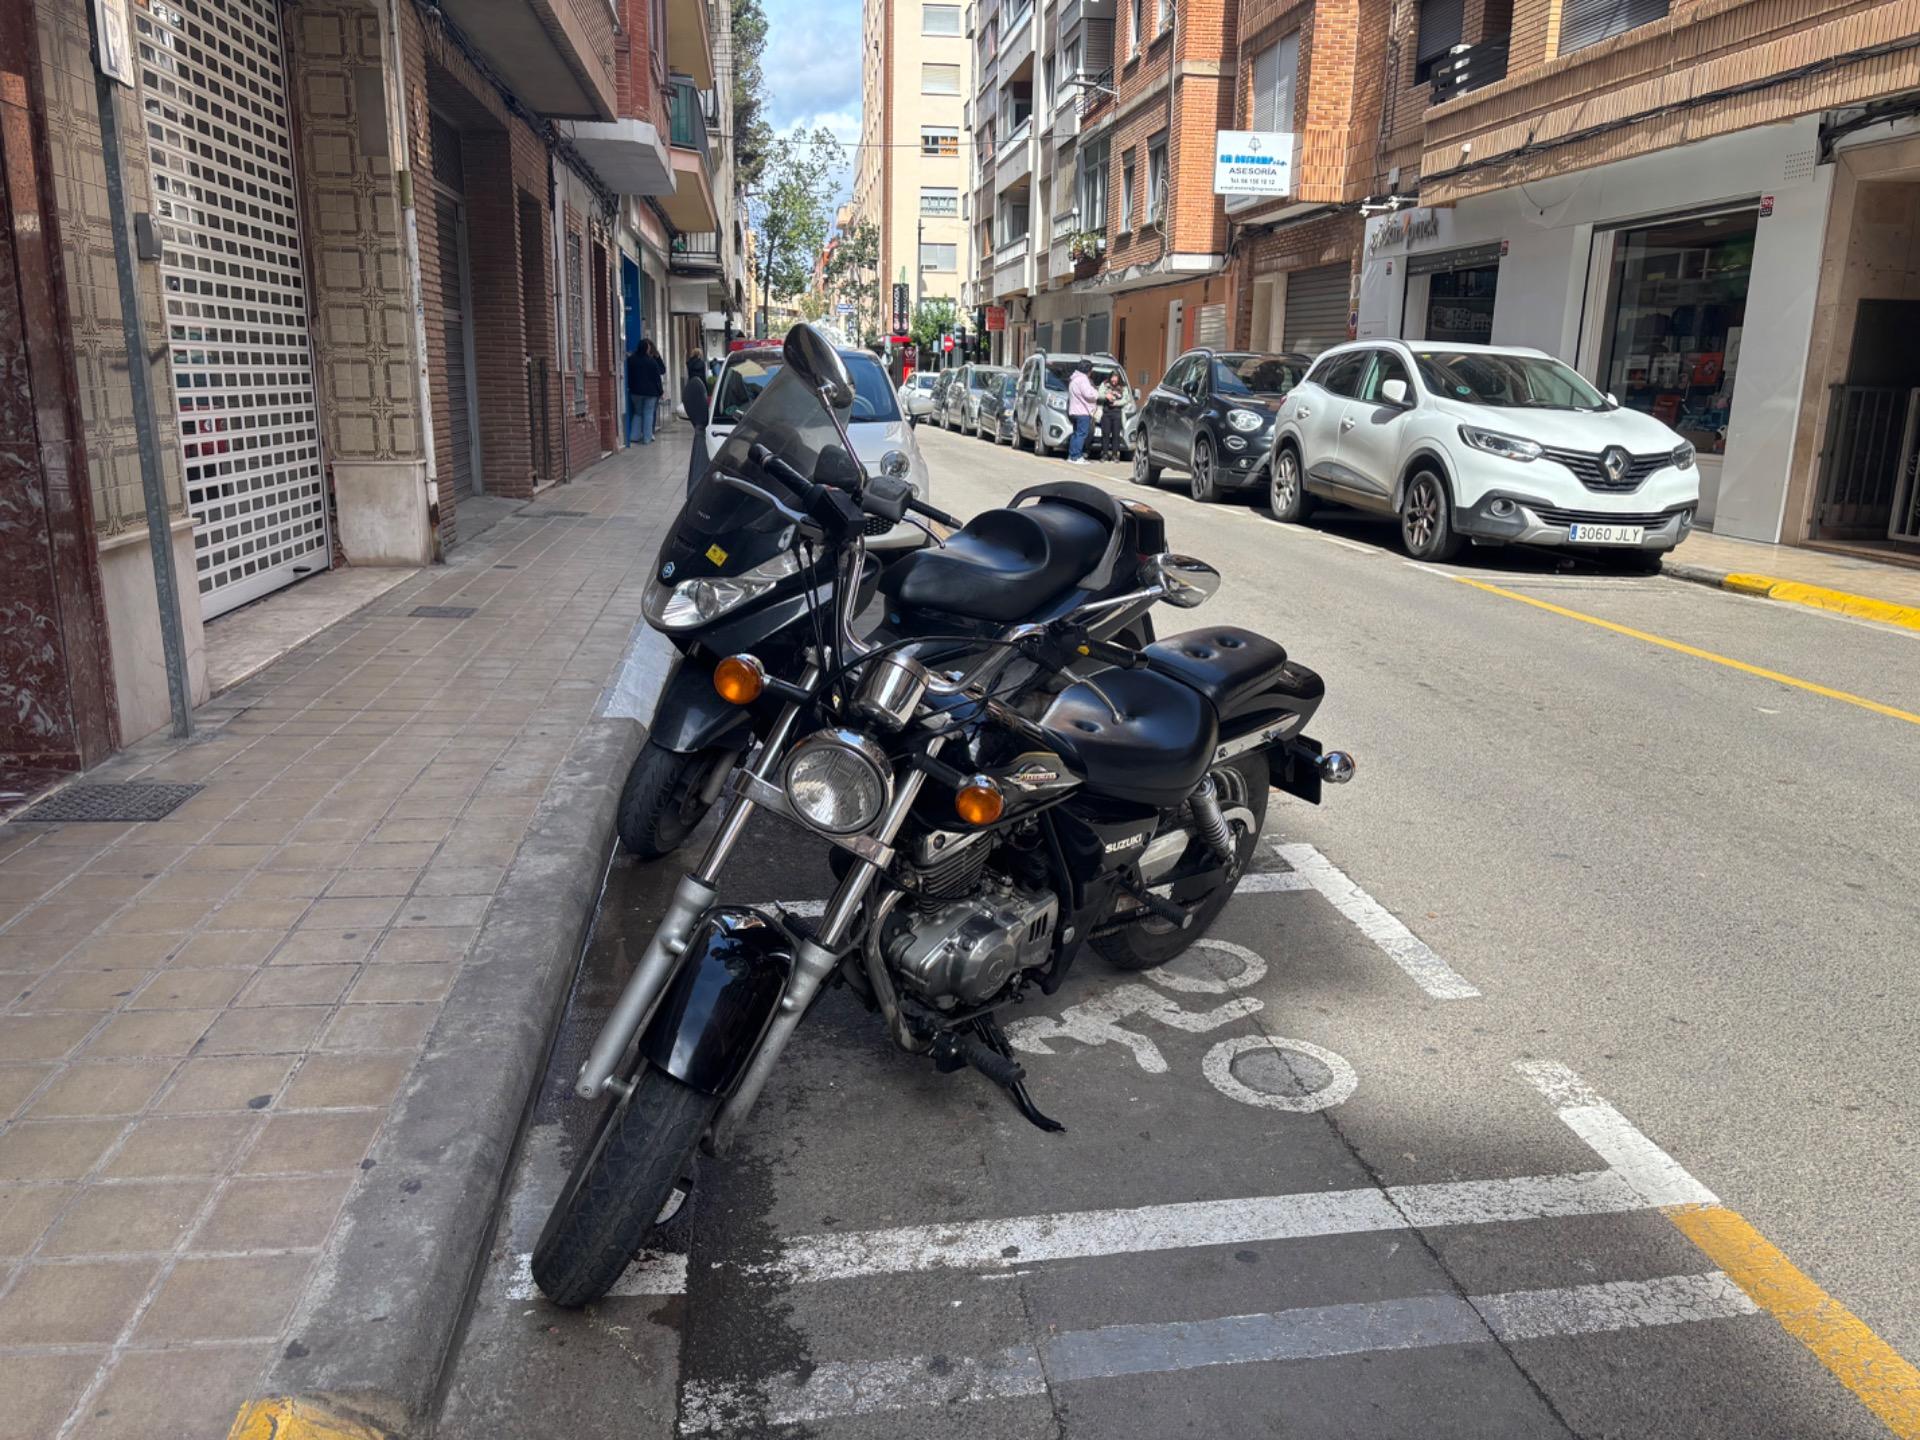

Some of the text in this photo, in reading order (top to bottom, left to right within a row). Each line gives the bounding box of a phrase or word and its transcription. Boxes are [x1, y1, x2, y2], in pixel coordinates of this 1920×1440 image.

[1229, 167, 1277, 176] ASESORÍA
[1579, 526, 1640, 542] 3060 JLY
[1105, 833, 1142, 853] SUZUKI
